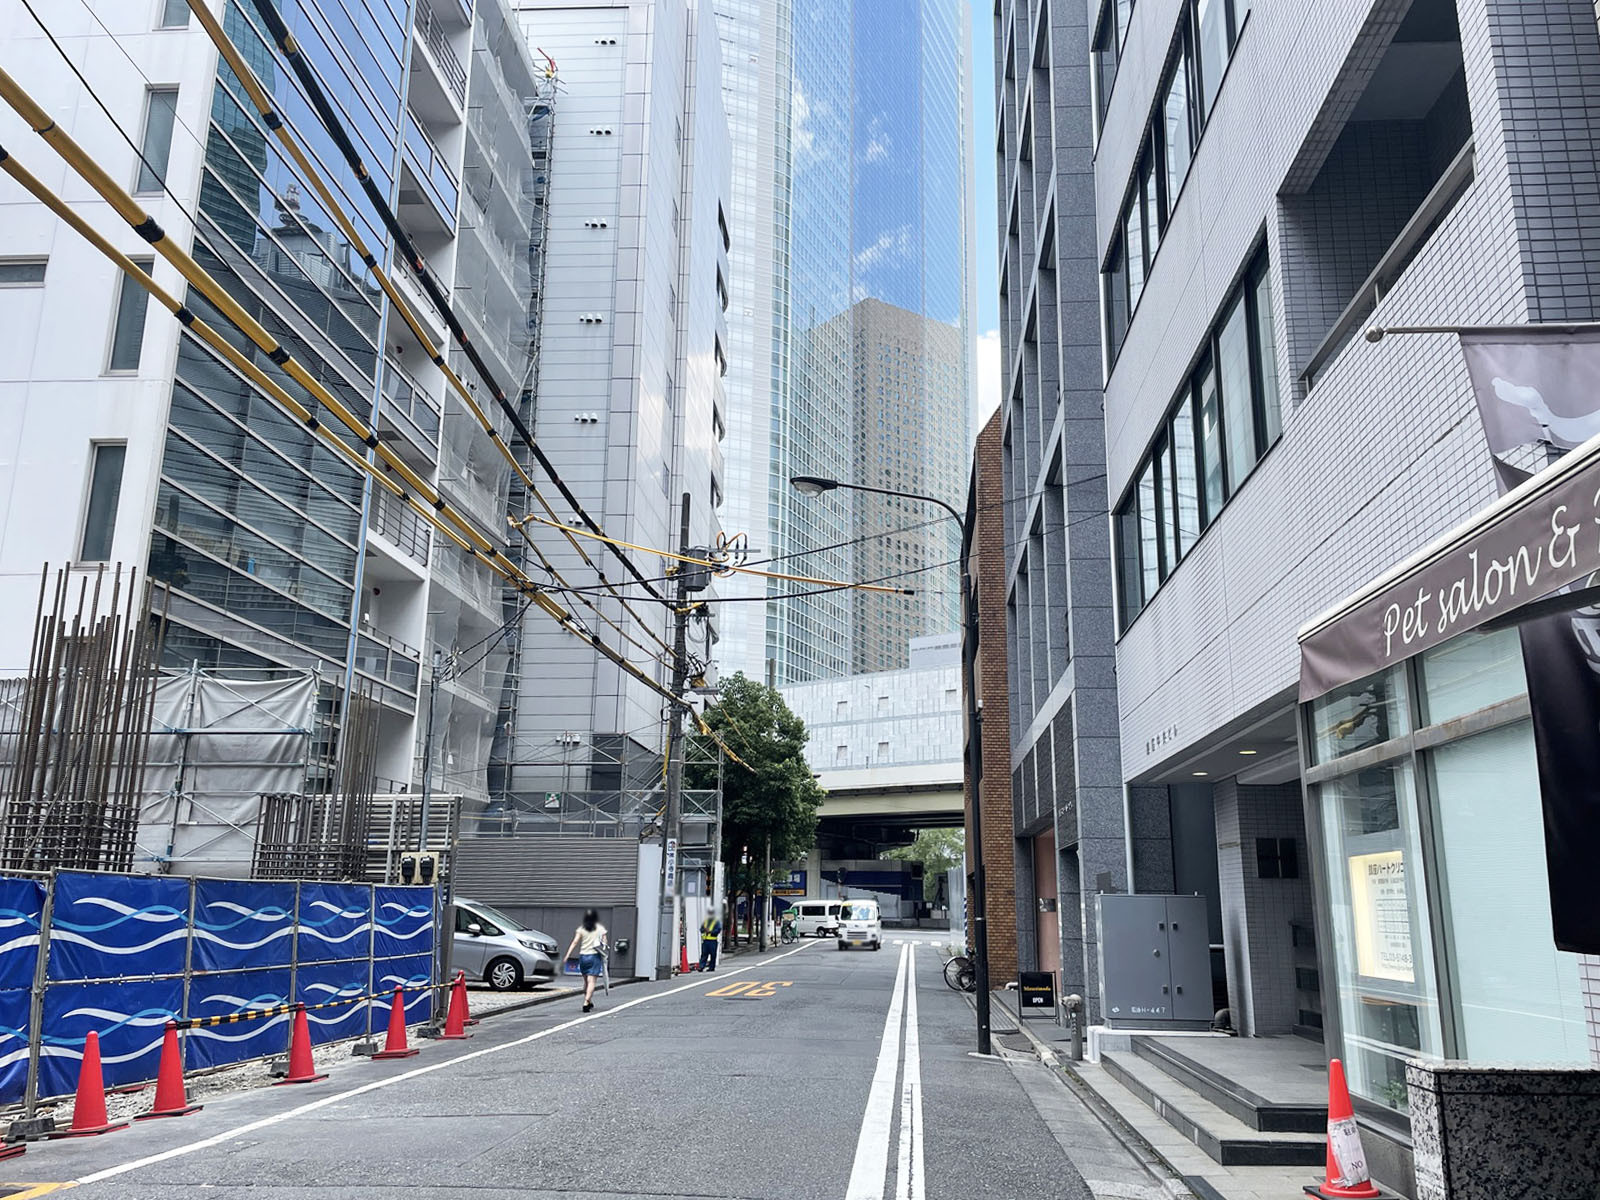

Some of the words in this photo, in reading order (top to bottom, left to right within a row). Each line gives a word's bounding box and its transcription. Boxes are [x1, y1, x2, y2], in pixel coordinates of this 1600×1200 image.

[1383, 587, 1431, 657] Pet
[1437, 544, 1542, 635] salon
[1548, 505, 1580, 569] &
[1351, 1160, 1363, 1170] NO
